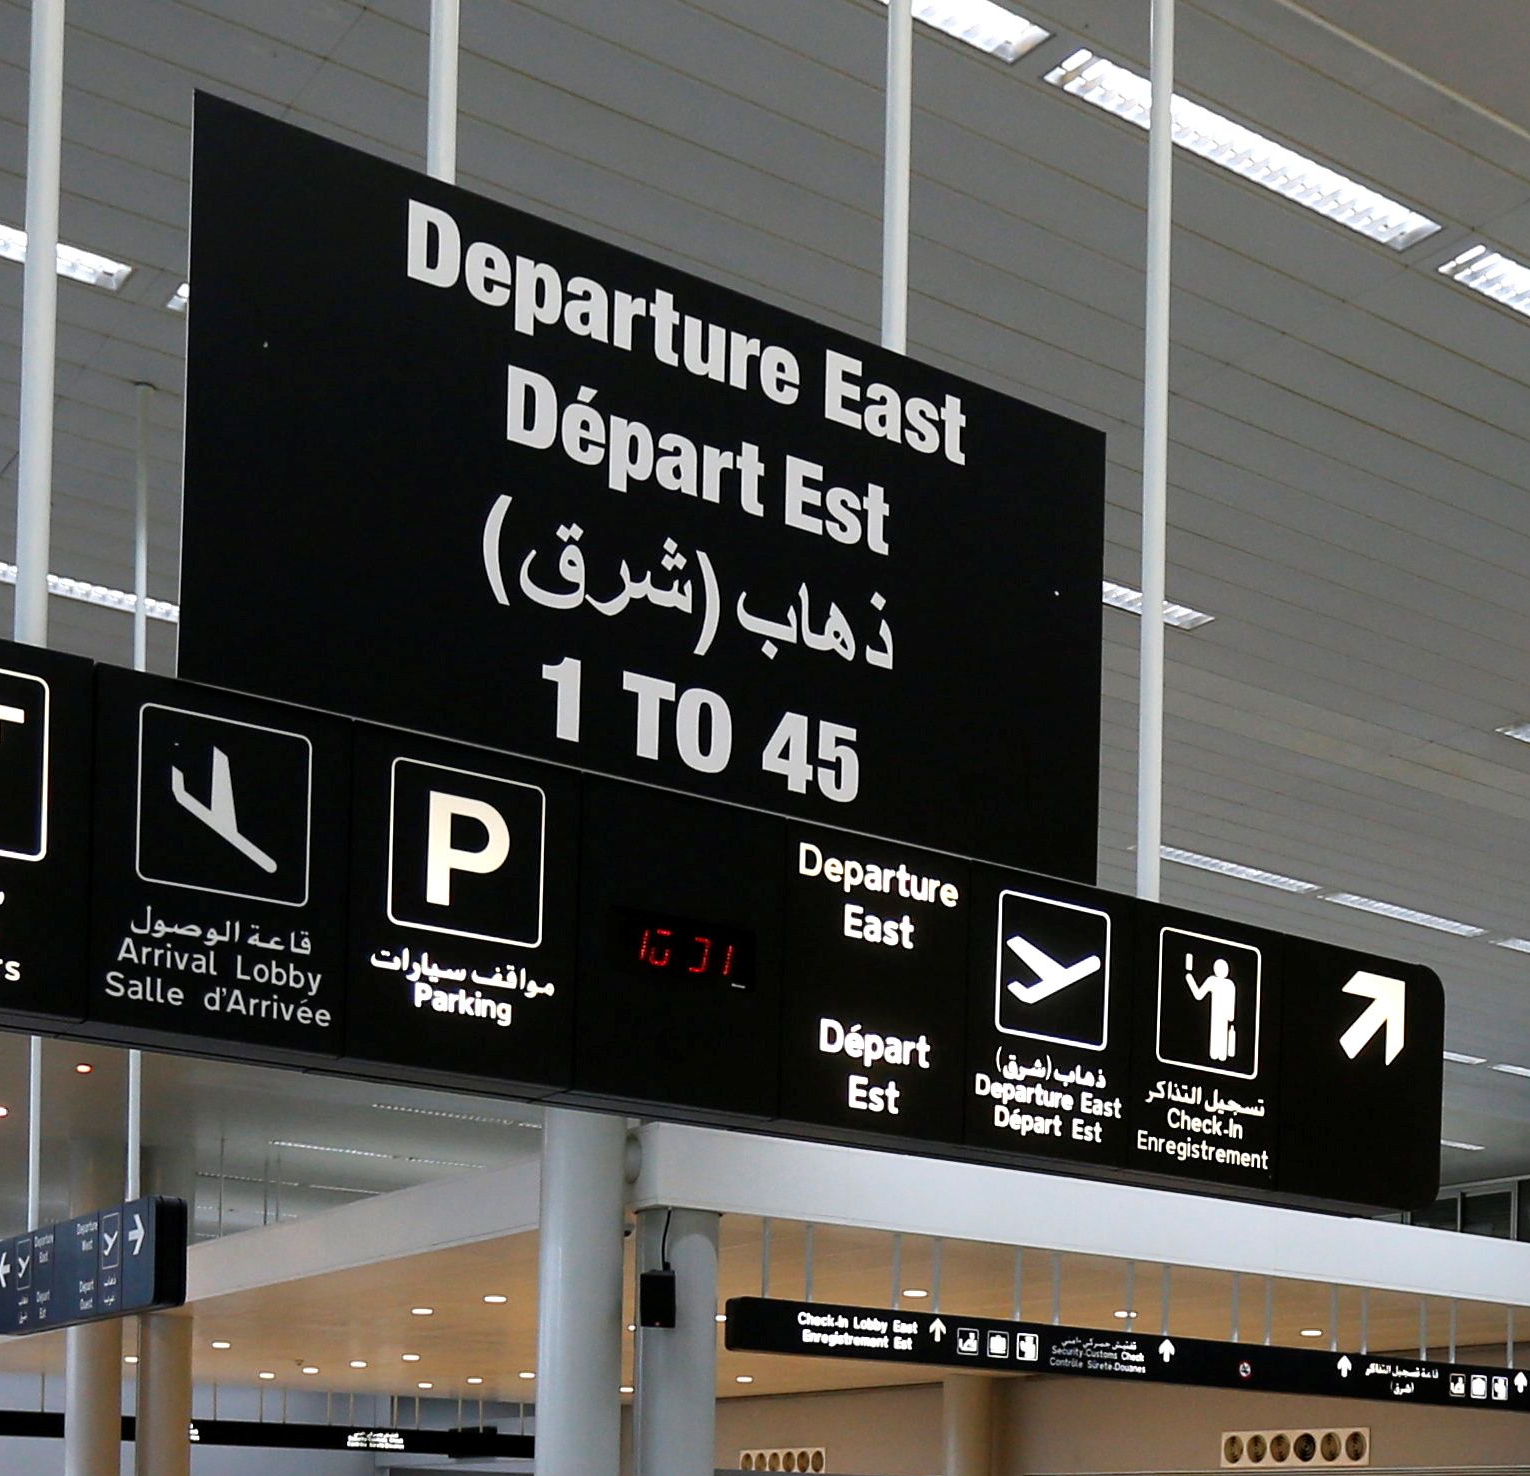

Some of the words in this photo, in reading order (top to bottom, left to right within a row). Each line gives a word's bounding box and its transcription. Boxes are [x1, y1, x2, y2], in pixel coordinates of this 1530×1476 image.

[408, 199, 800, 406] Departure
[825, 348, 967, 465] East
[507, 364, 764, 516] Départ
[786, 454, 889, 555] Est
[483, 494, 720, 655] (شرق)
[737, 583, 894, 669] ذهاب
[542, 656, 580, 743] 1
[623, 670, 731, 773] TO
[762, 711, 859, 801] 45
[426, 790, 510, 906] P
[799, 842, 958, 908] Departure
[130, 905, 240, 948] الوصول
[248, 925, 311, 955] قاعة
[843, 904, 914, 949] East
[118, 938, 217, 977] Arrival
[237, 955, 322, 995] Lobby
[371, 947, 467, 984] سيارات
[471, 964, 554, 998] مواقف
[105, 972, 184, 1008] Salle
[204, 986, 331, 1028] d'Arrivée
[414, 984, 512, 1026] Parking
[819, 1018, 930, 1070] Départ
[848, 1075, 899, 1115] Est
[975, 1073, 1073, 1112] Departure
[1080, 1091, 1122, 1120] East
[1055, 1064, 1106, 1089] ذهاب
[1145, 1080, 1202, 1111] التذاكر
[994, 1107, 1061, 1140] Départ
[1071, 1117, 1102, 1143] Est
[1167, 1107, 1243, 1140] Check-In
[1206, 1094, 1266, 1119] تسجيل
[1137, 1129, 1268, 1171] Enregistrement
[802, 1328, 889, 1347] Enregistrement
[893, 1336, 913, 1350] Est
[853, 1316, 888, 1334] Lobby
[893, 1320, 918, 1334] East
